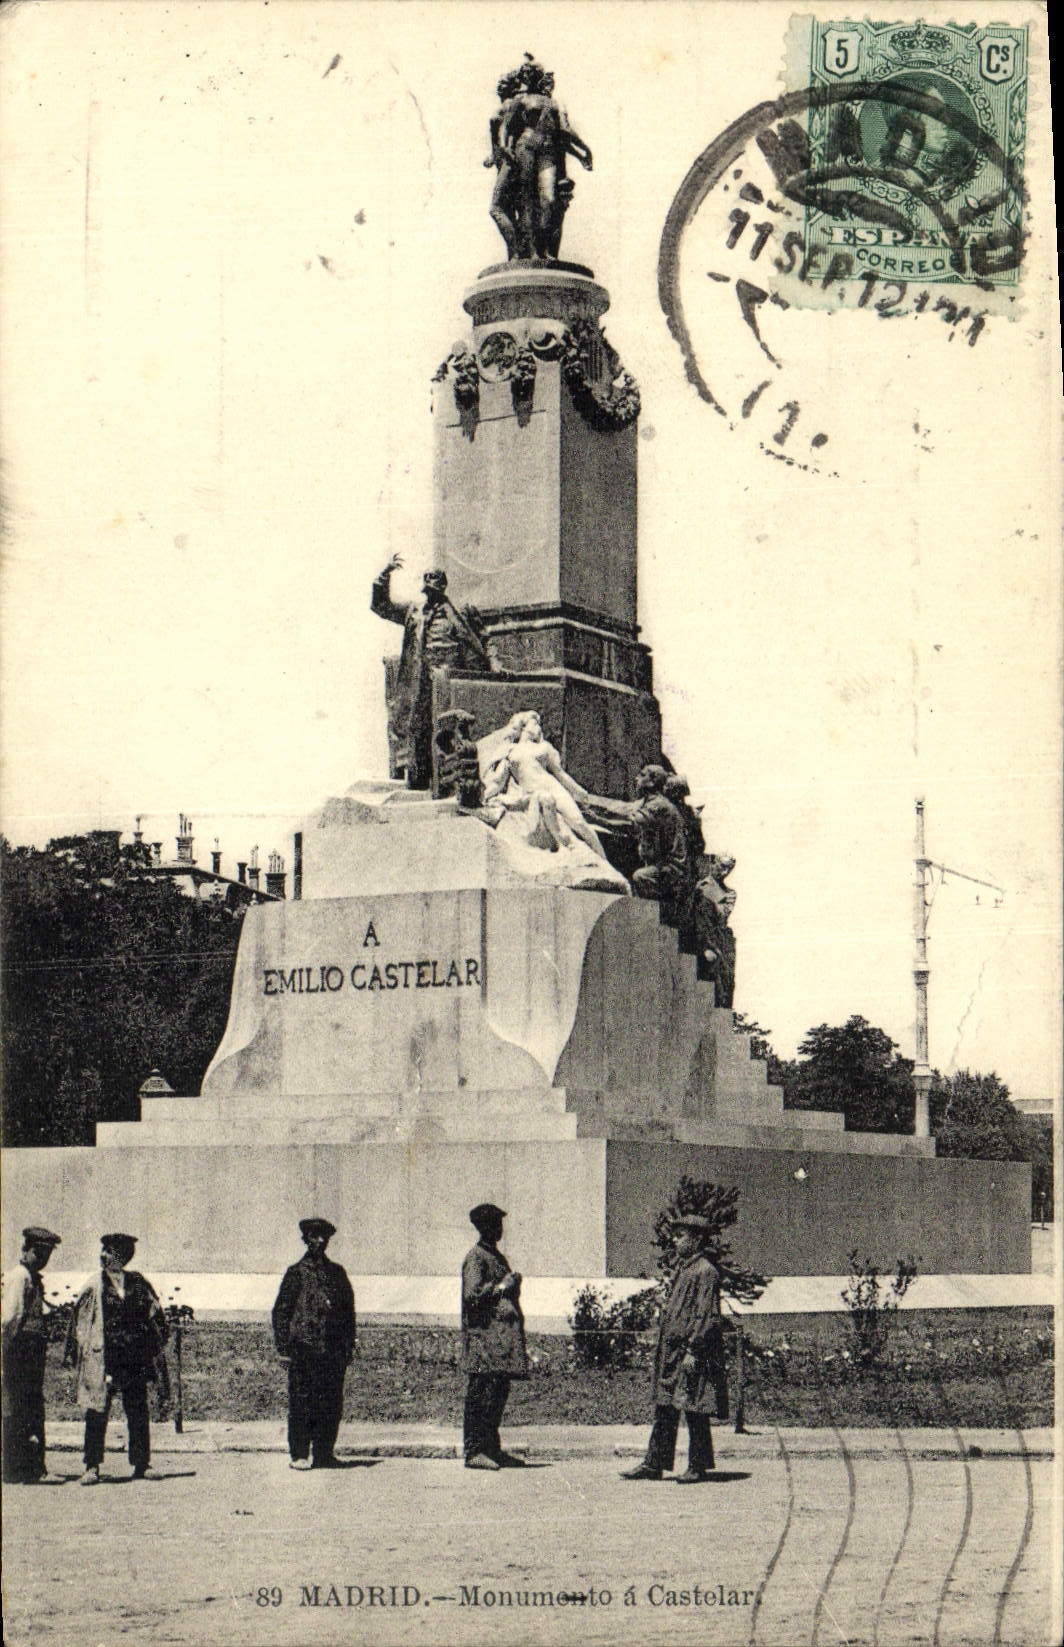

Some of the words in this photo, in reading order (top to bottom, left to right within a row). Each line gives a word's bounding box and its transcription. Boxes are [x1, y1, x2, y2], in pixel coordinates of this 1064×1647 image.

[834, 38, 849, 69] 5
[362, 920, 381, 948] A
[262, 965, 345, 996] EMILIO
[350, 957, 482, 991] CASTELAR
